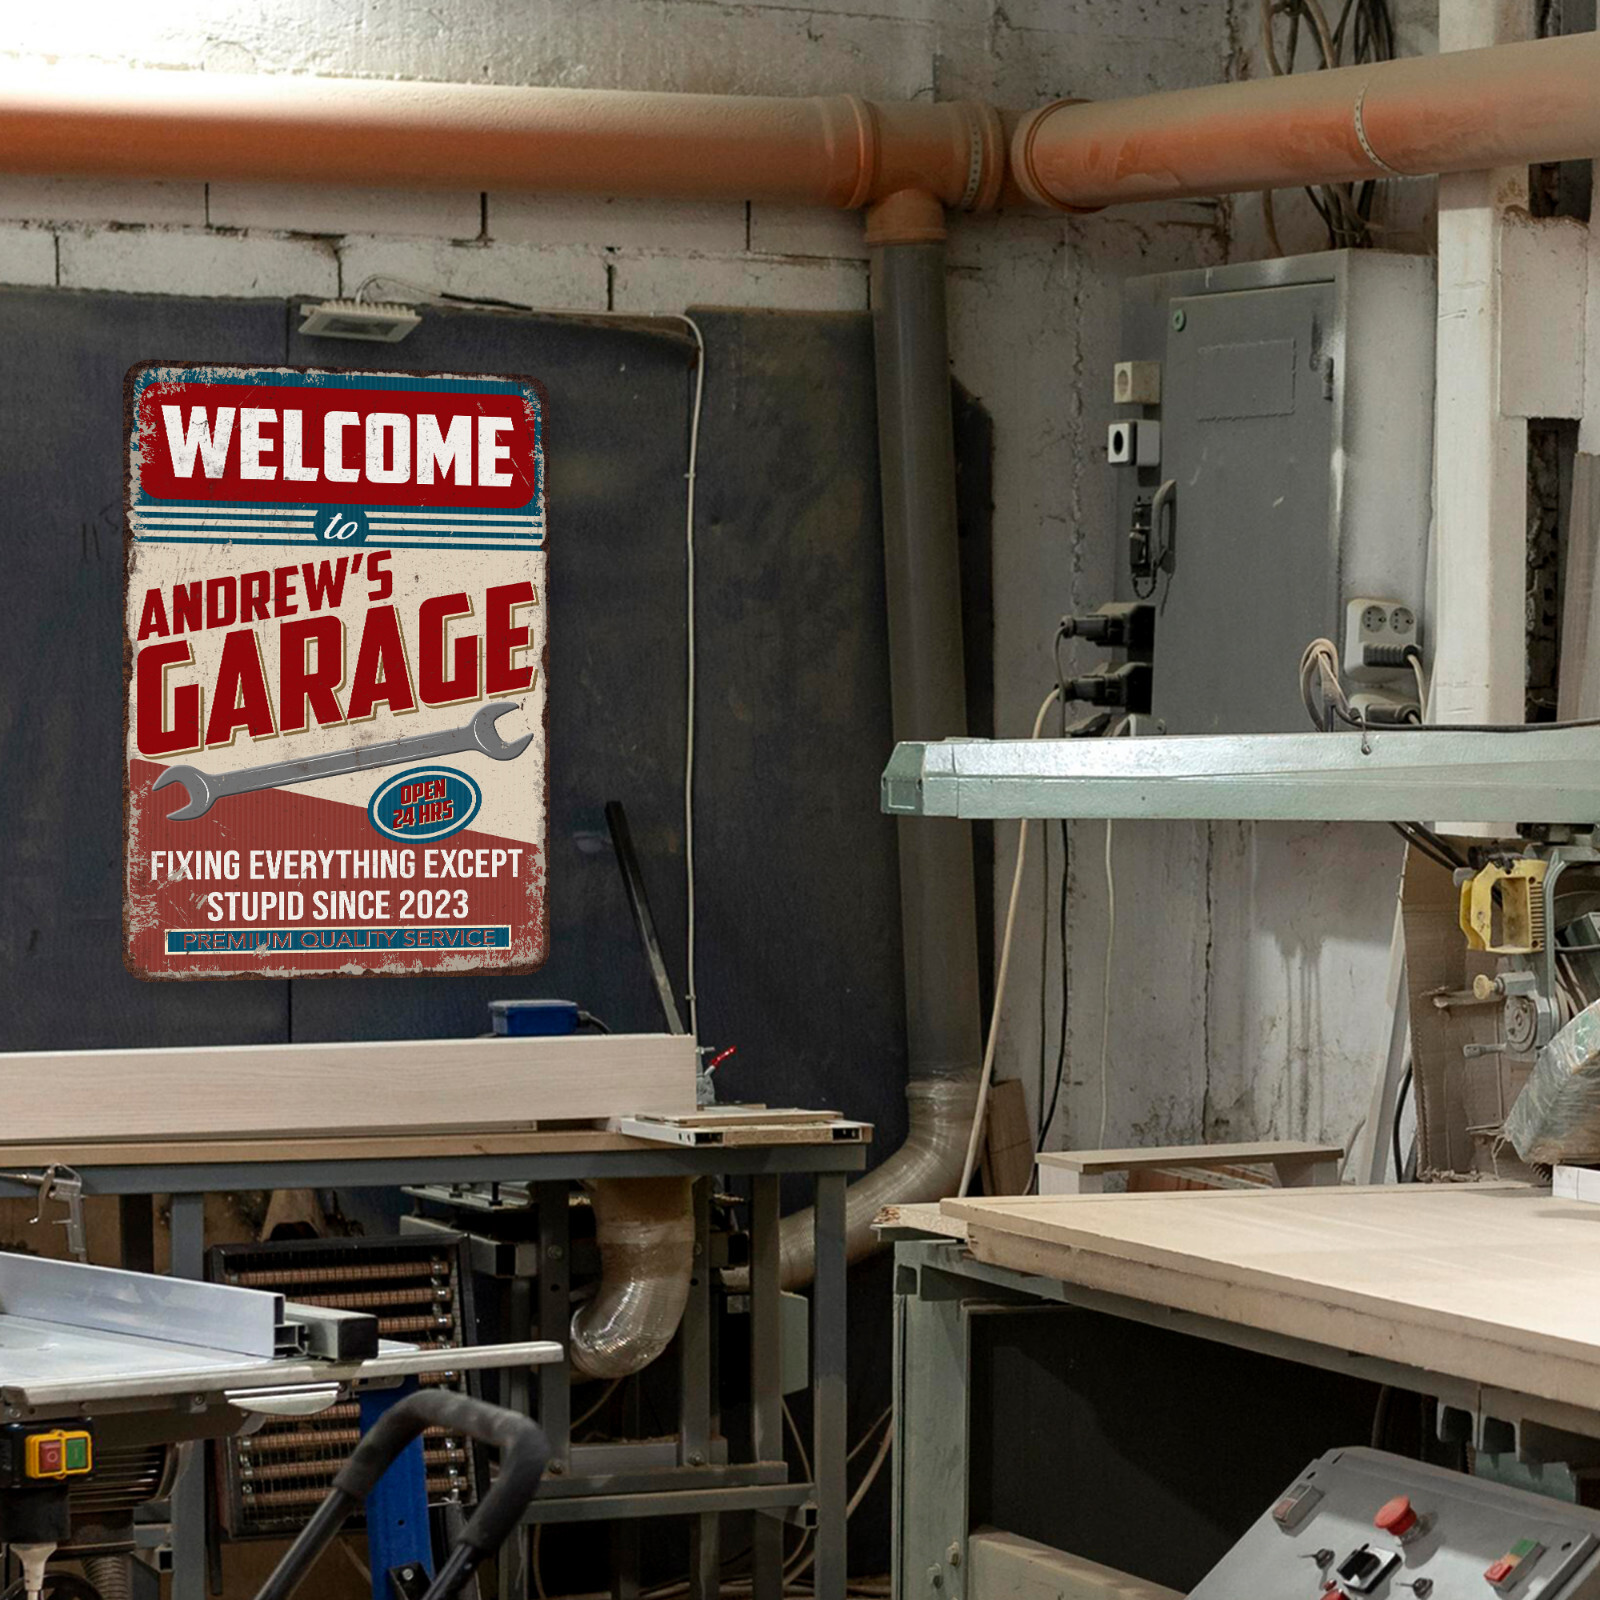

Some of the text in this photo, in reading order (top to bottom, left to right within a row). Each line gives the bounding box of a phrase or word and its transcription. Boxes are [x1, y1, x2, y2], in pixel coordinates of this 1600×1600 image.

[161, 404, 514, 487] WELCOME
[323, 512, 359, 540] to
[136, 581, 539, 758] GARAGE
[400, 778, 447, 806] OPEN
[392, 800, 454, 830] 24 HRS
[151, 848, 523, 881] FIXING EVERYTHING EXCEPT
[207, 889, 469, 922] STUPID SINCE 2023
[183, 929, 496, 951] PREMIUM QUALITY SERVICE
